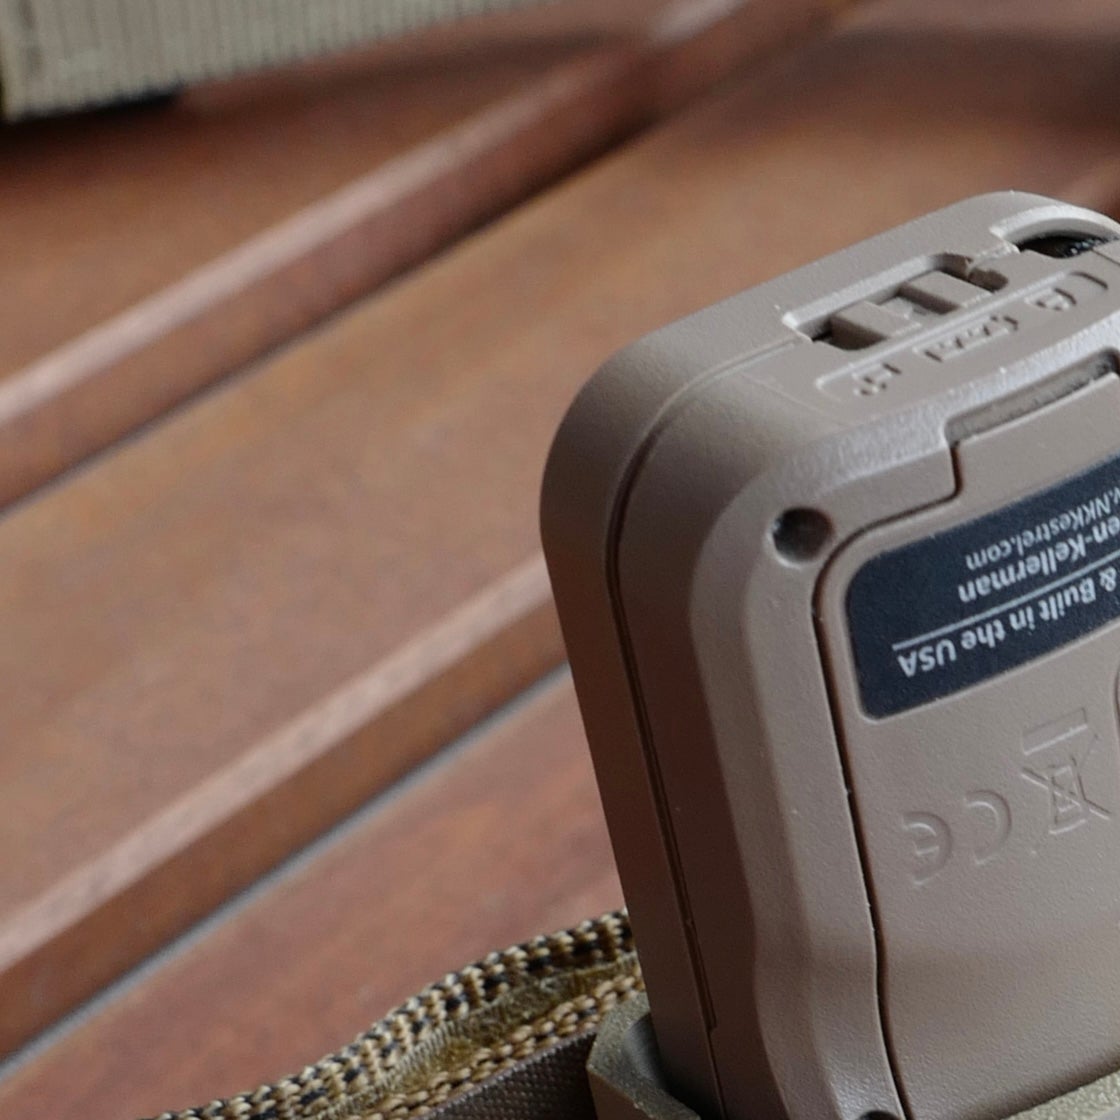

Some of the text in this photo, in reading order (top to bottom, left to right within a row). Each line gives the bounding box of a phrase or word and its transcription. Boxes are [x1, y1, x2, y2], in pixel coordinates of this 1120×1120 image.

[1100, 571, 1117, 593] &
[1040, 577, 1097, 622] Built
[961, 619, 1006, 650] the
[1010, 606, 1035, 632] in
[897, 640, 957, 678] USA
[900, 788, 1013, 887] CE
